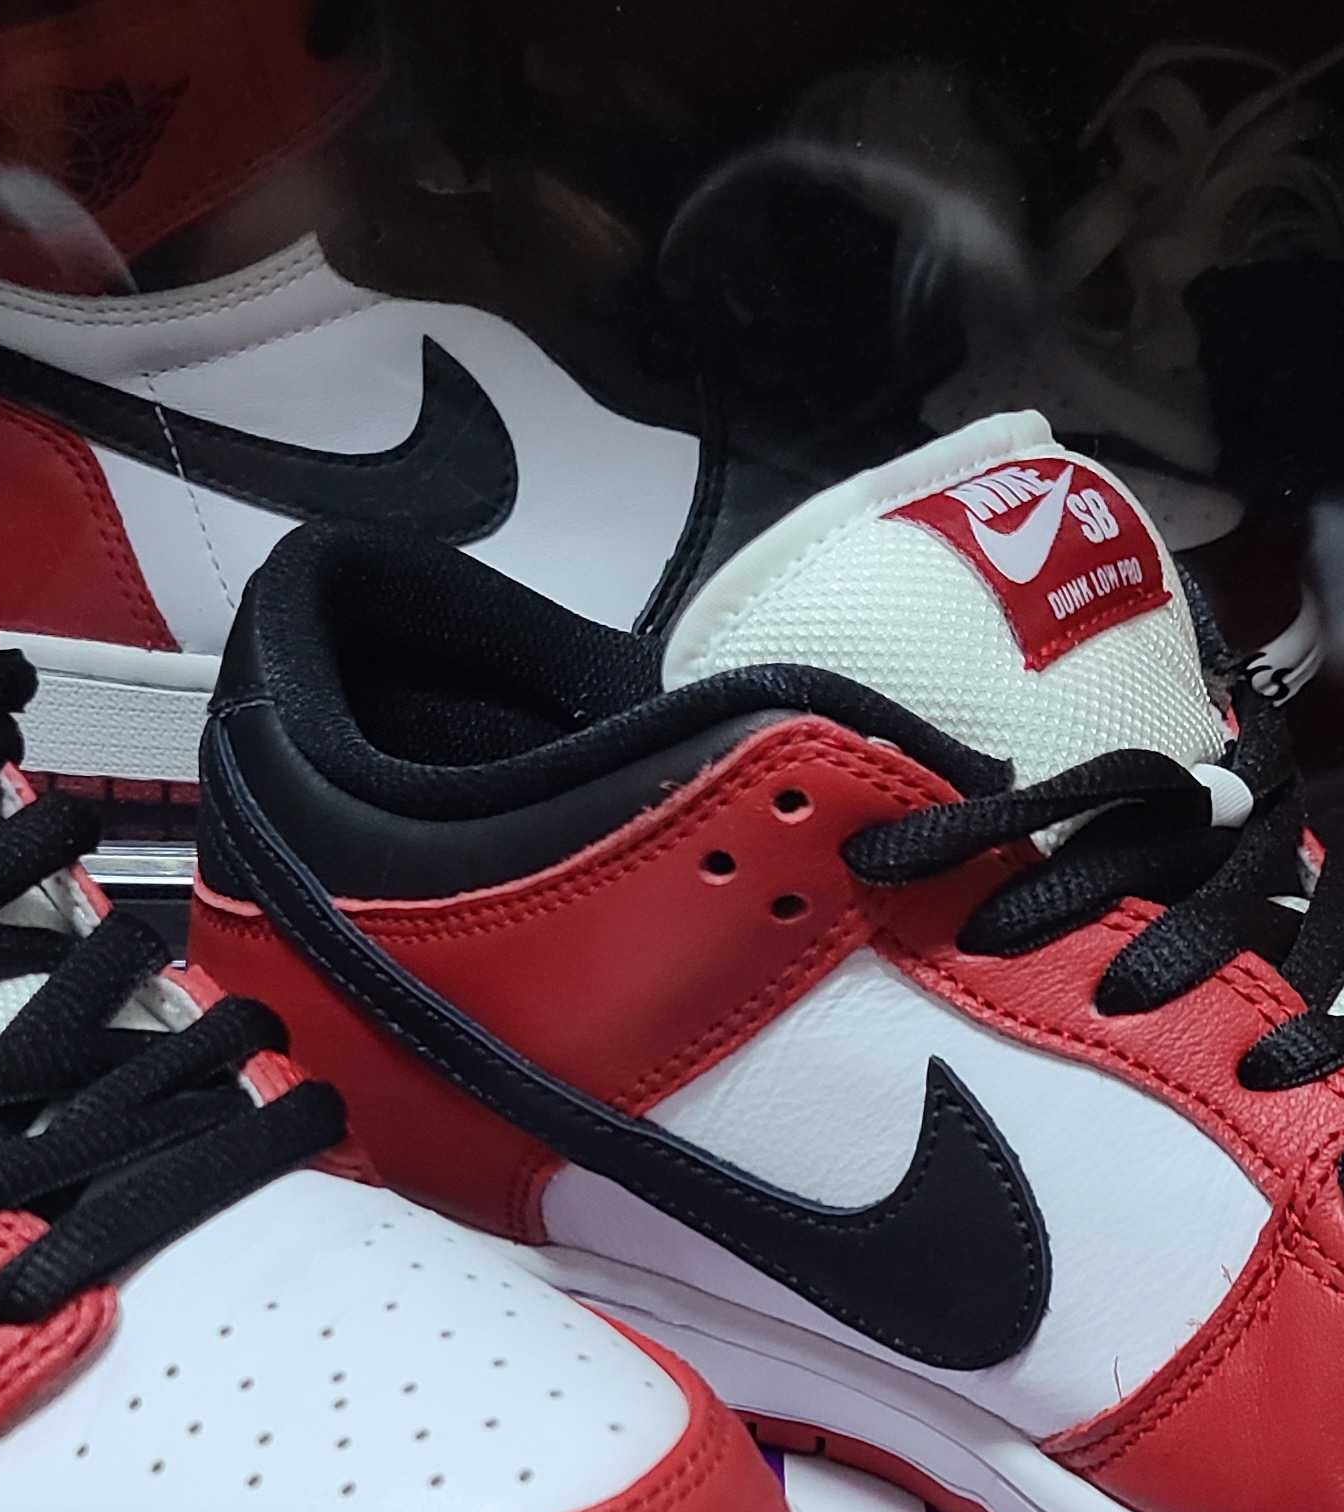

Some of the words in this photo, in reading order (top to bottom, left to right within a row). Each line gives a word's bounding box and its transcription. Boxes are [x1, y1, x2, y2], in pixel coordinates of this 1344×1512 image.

[1066, 488, 1120, 543] SB
[1046, 575, 1095, 620] DUNK
[1089, 564, 1121, 597] LOW
[1117, 556, 1144, 587] PRO
